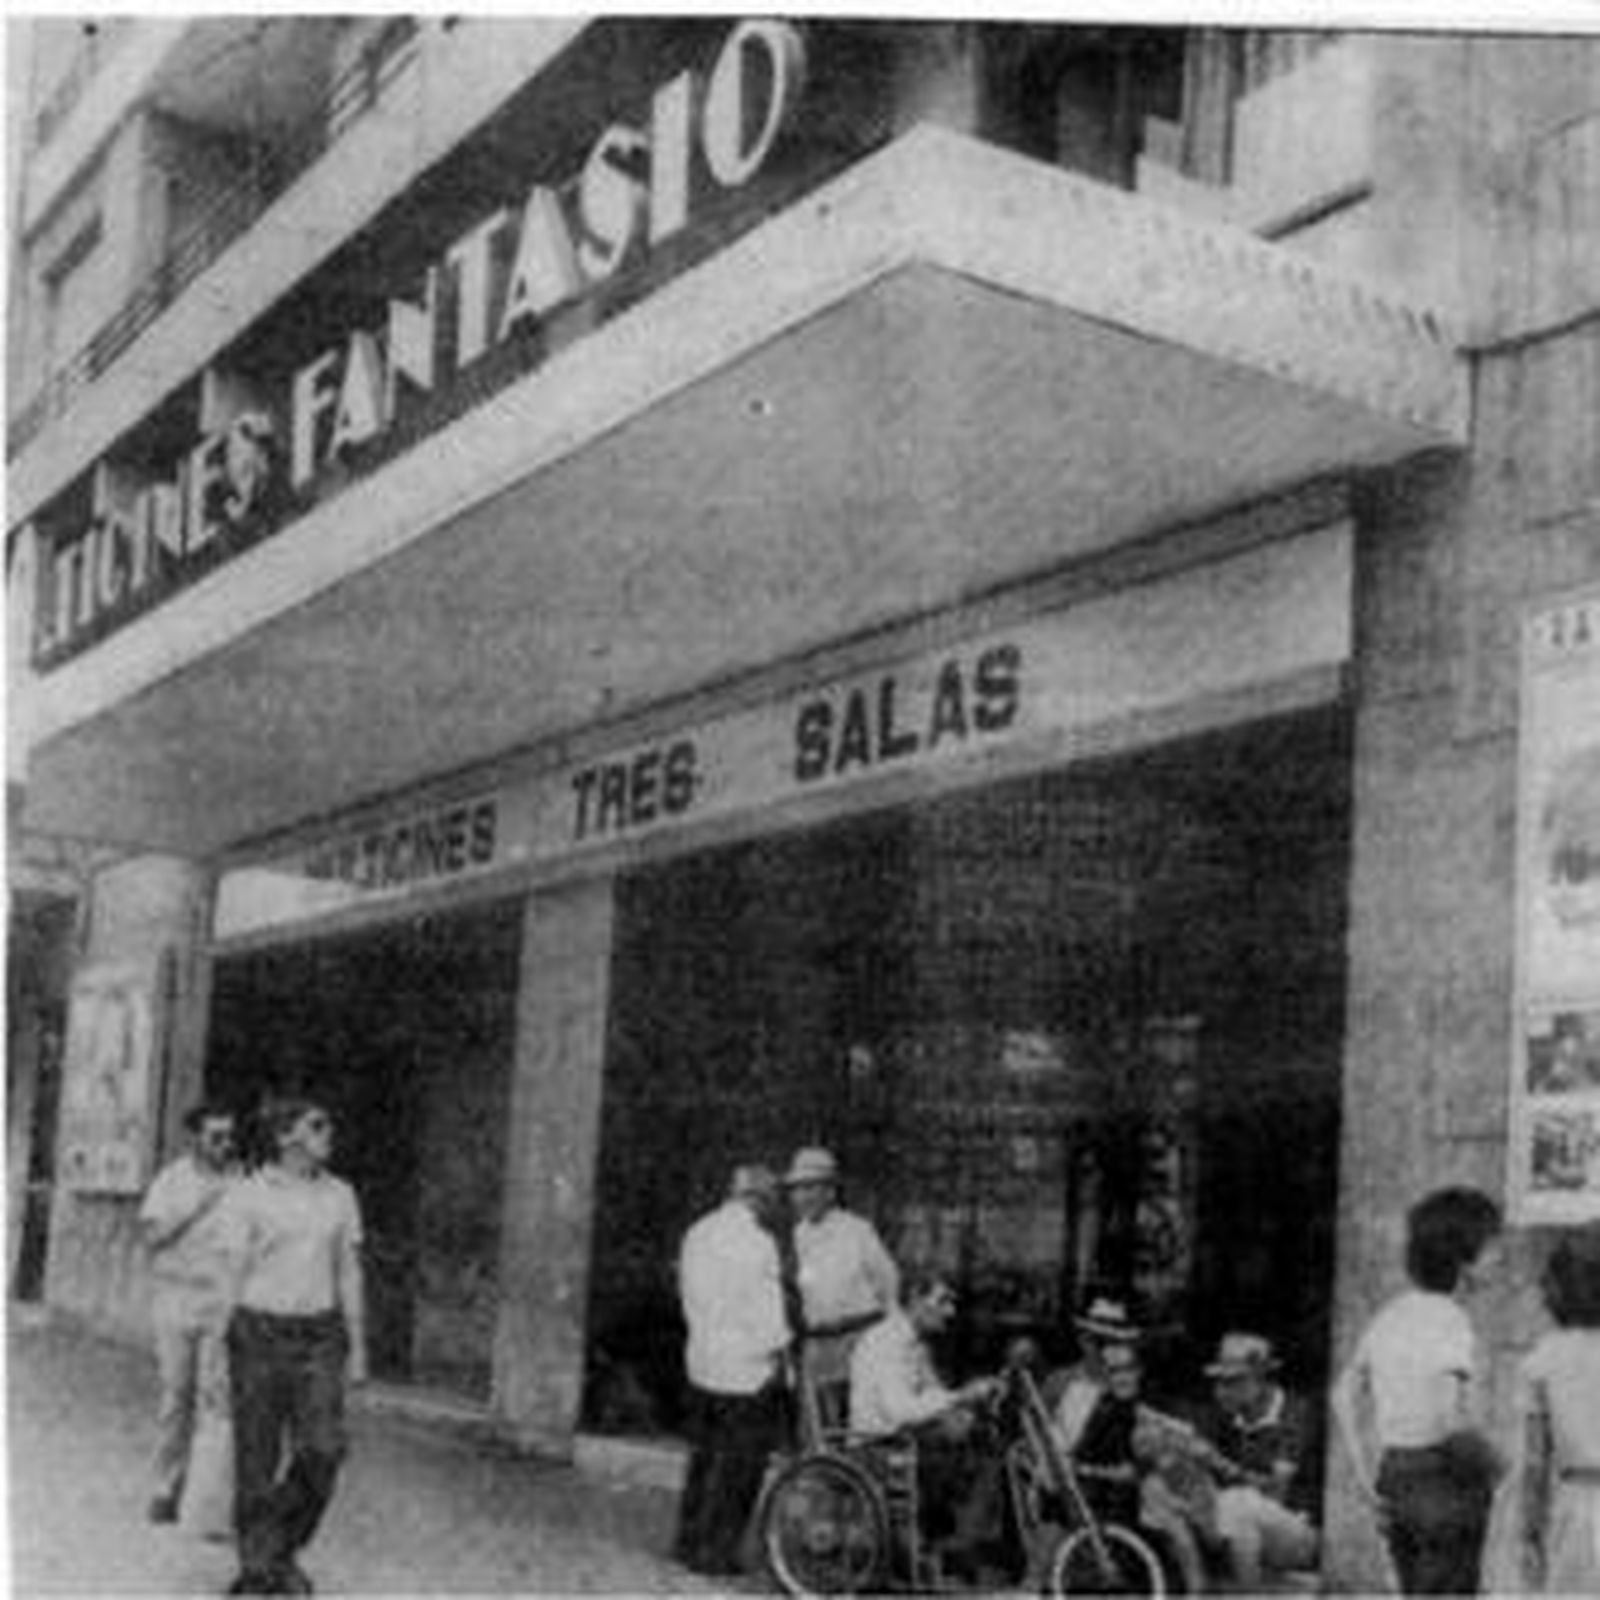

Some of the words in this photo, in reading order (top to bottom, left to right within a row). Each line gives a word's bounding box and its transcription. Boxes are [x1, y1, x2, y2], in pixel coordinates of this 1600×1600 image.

[292, 18, 804, 489] FANTASIO
[572, 739, 698, 841] TRES
[795, 644, 1021, 783] SALAS
